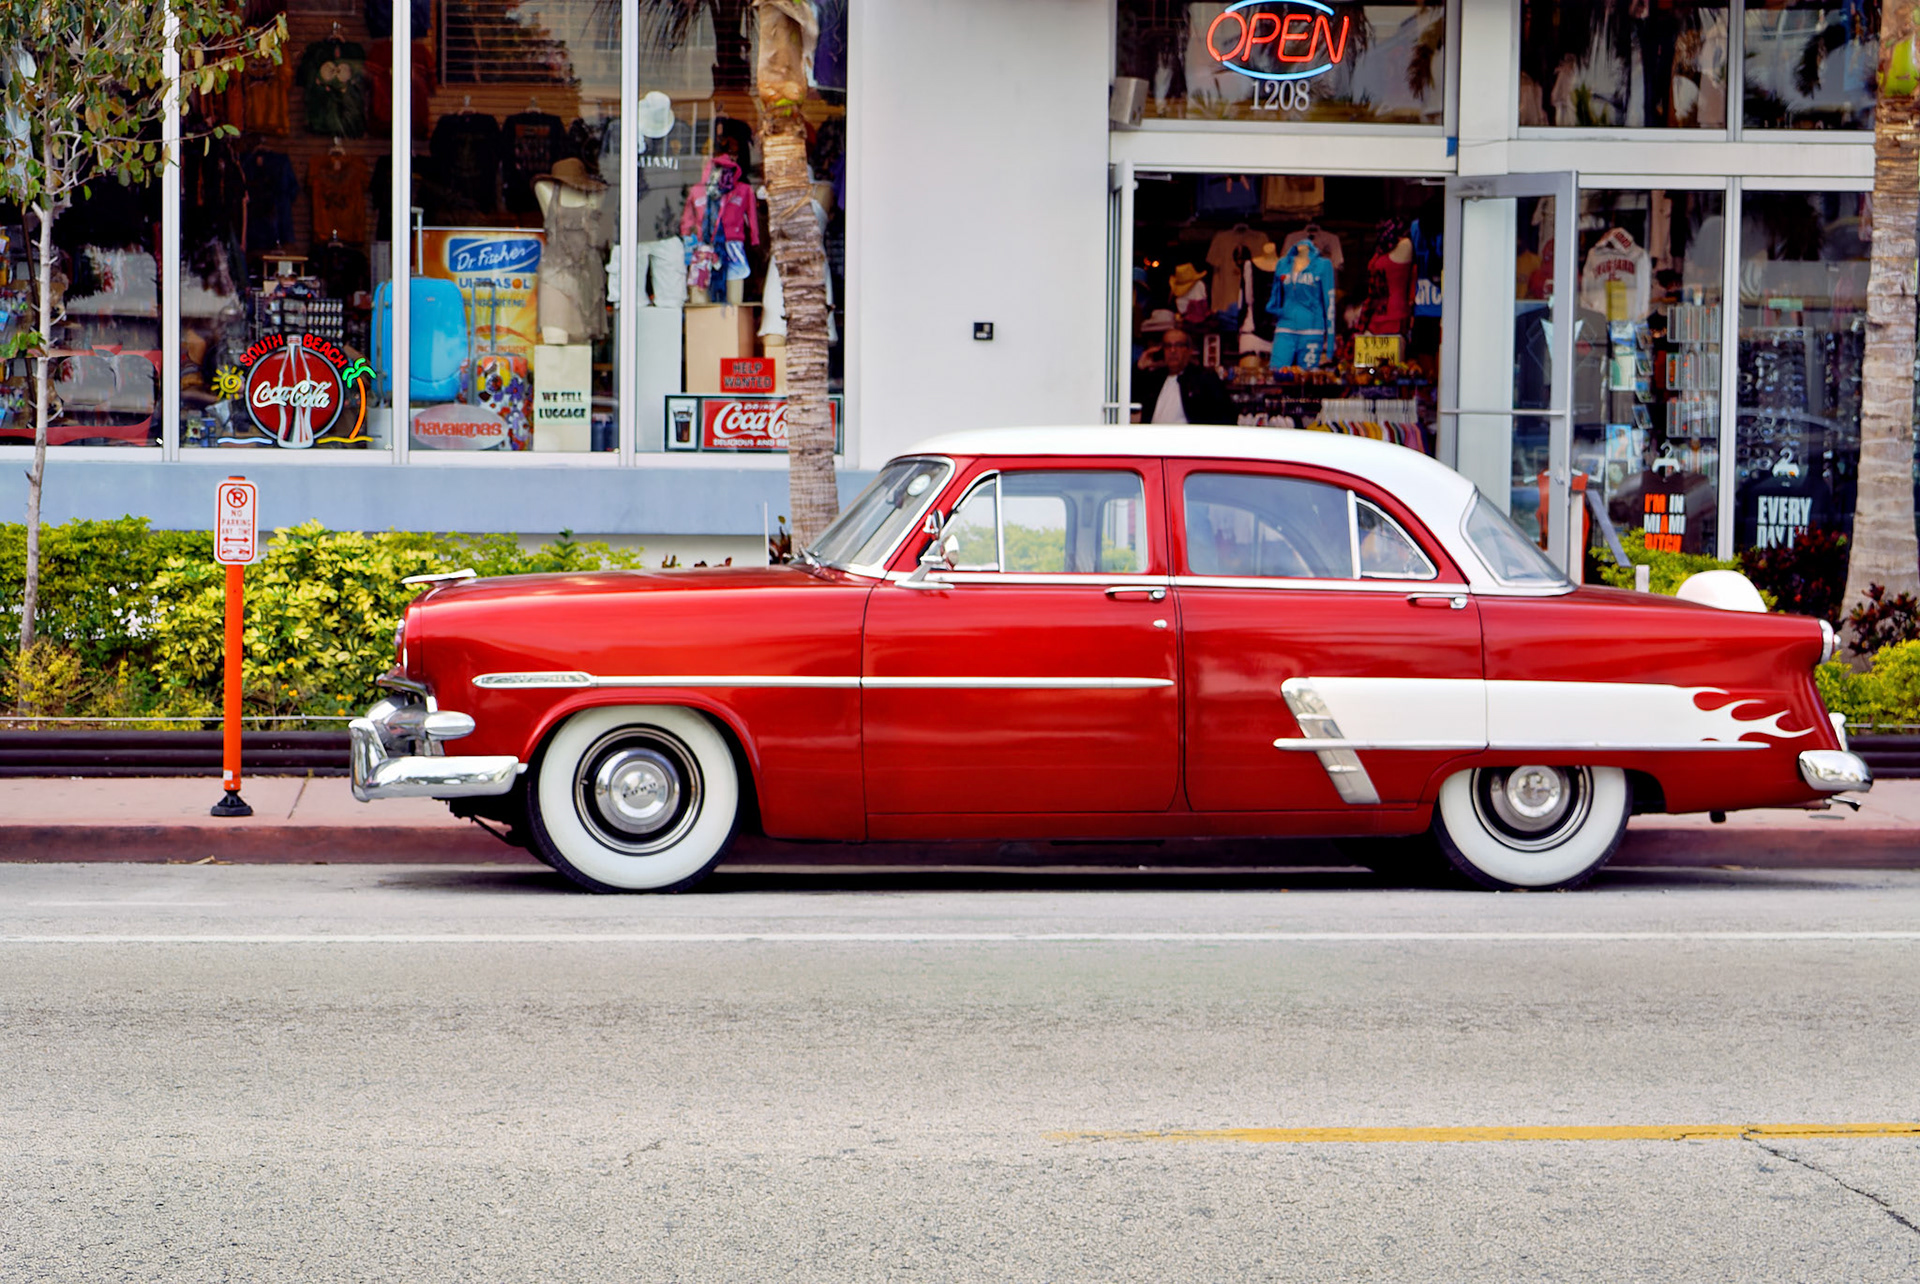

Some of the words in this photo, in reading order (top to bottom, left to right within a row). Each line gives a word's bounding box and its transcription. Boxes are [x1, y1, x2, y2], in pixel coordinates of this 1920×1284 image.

[1207, 11, 1349, 63] OPEN
[1251, 80, 1310, 111] 1208
[239, 333, 283, 367] SOUTH
[303, 333, 348, 368] BEACH
[733, 362, 763, 375] HELP
[724, 376, 772, 389] WANTED
[542, 392, 557, 402] WE
[561, 392, 582, 402] SELL
[539, 408, 586, 418] LUGGAGE
[414, 418, 502, 438] havaianas
[231, 509, 243, 517] NO
[1669, 493, 1685, 514] IN
[1757, 495, 1812, 526] EVERY
[222, 518, 252, 527] PARKING
[1643, 513, 1687, 535] MIAMI
[1756, 524, 1786, 549] DAY
